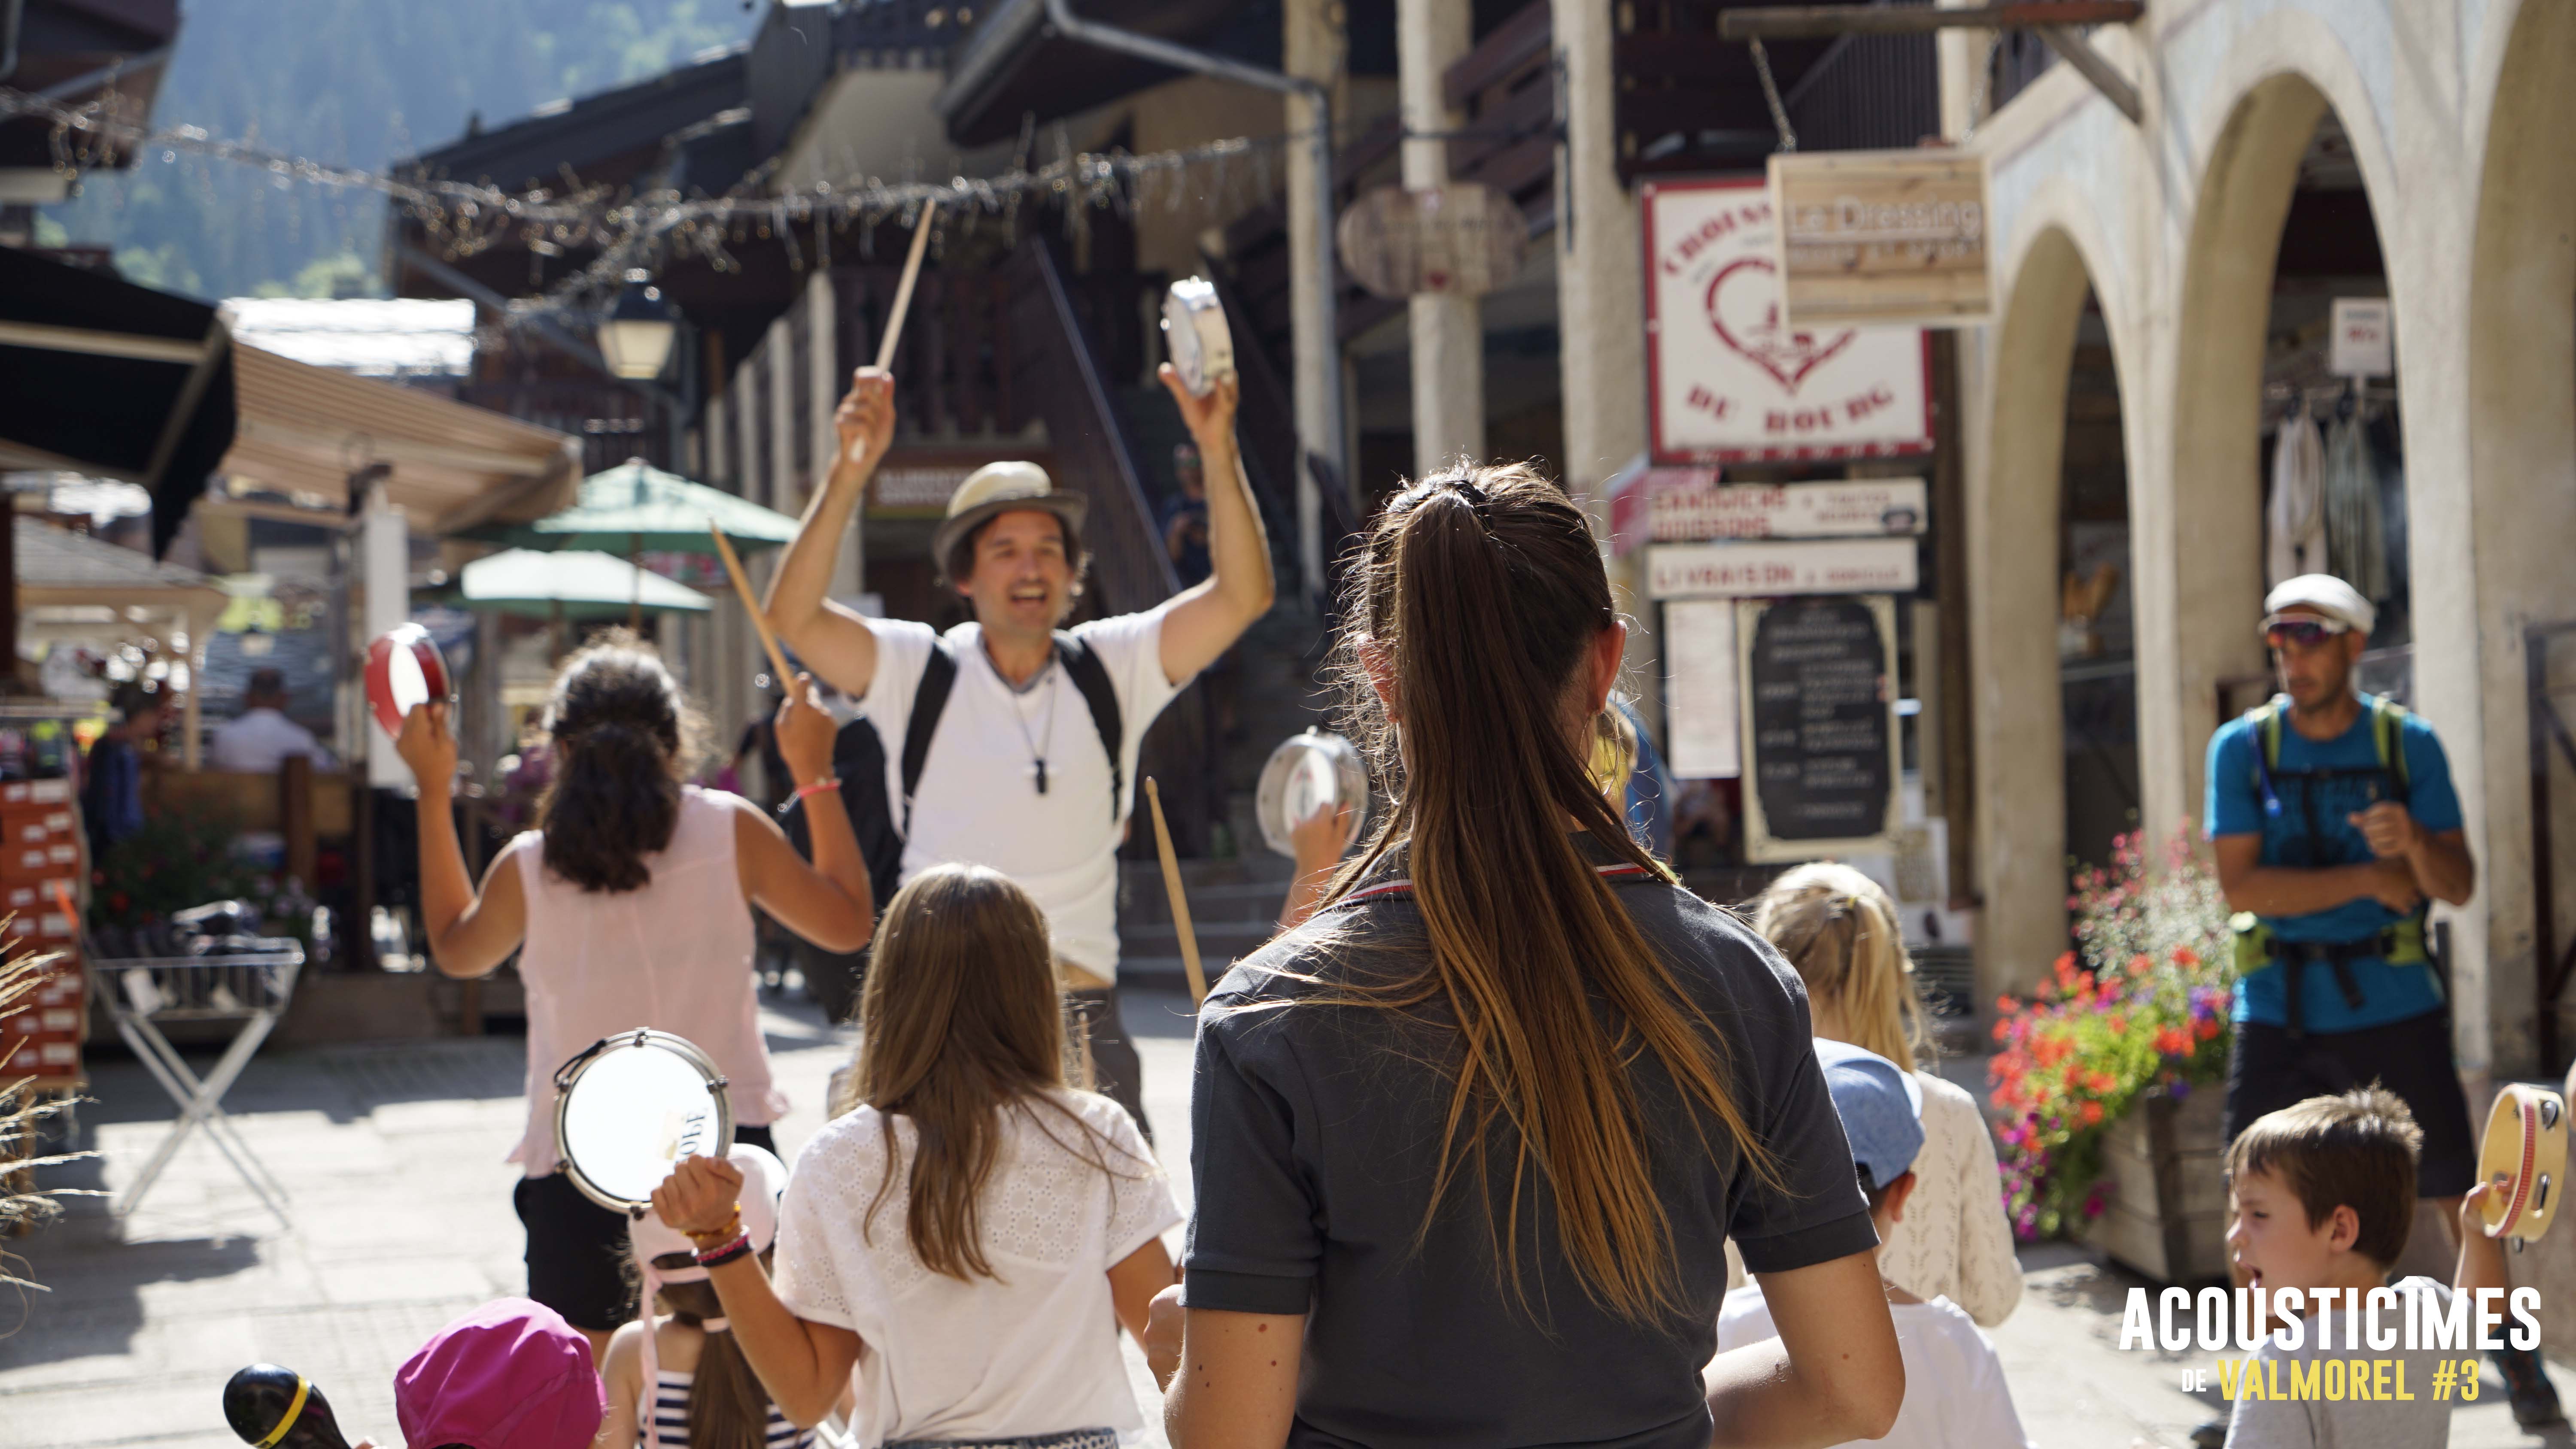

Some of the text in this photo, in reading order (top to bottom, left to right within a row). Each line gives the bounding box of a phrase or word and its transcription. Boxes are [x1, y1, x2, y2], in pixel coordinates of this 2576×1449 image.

[1789, 195, 1981, 239] Le Dressing
[1656, 564, 1793, 588] LIVRAISON
